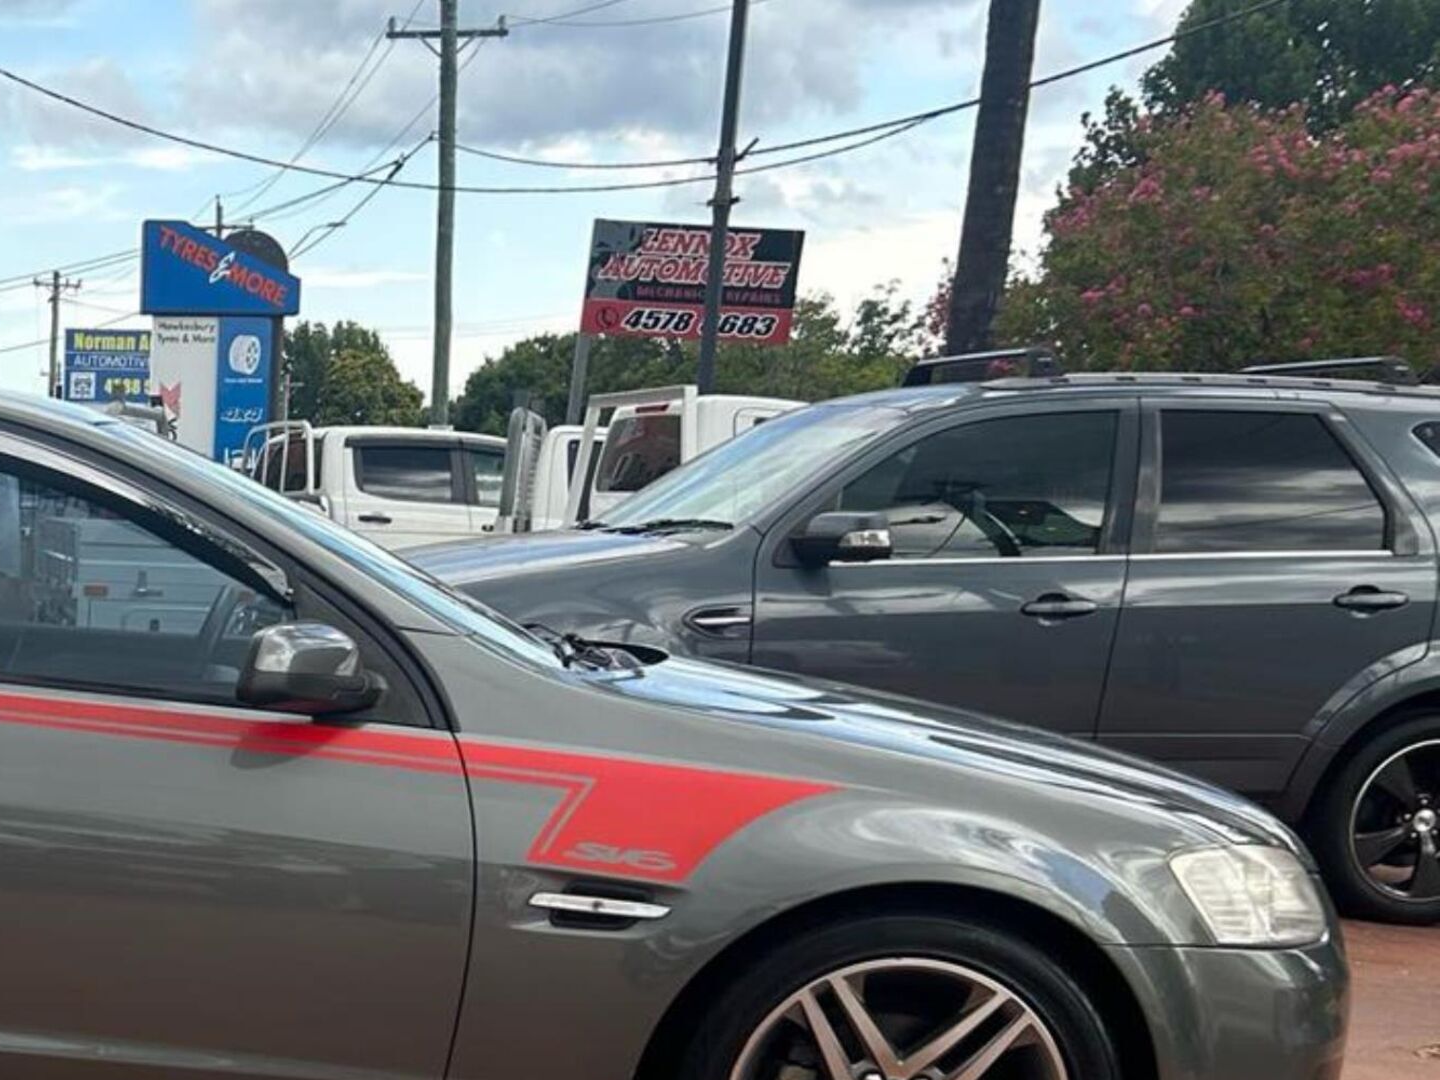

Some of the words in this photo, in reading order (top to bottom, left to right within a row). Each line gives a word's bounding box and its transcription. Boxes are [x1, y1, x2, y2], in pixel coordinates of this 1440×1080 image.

[161, 225, 219, 272] TYRES
[228, 262, 289, 308] MORE
[598, 253, 791, 289] AUTOMTIVE
[621, 307, 697, 335] 4578
[697, 312, 779, 338] 683
